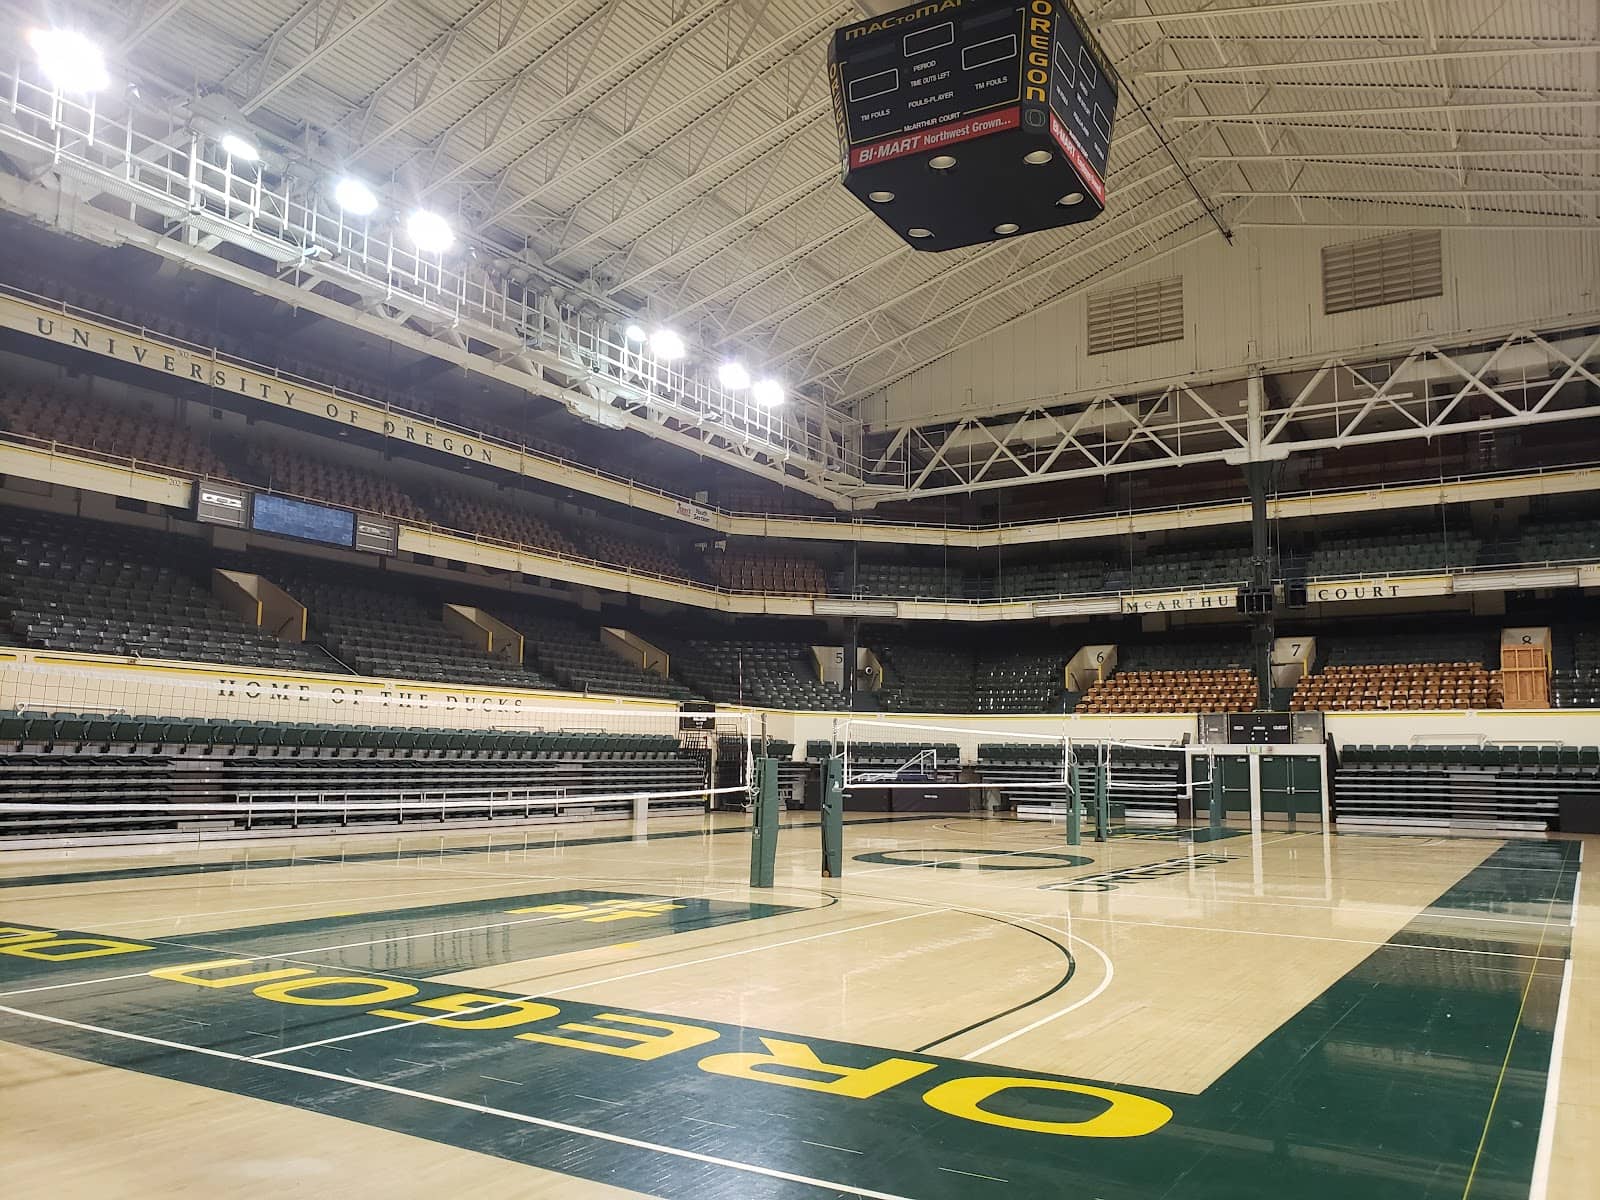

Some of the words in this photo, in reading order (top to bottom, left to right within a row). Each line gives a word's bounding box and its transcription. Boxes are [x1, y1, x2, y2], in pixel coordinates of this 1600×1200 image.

[1026, 0, 1053, 102] OREGON
[913, 60, 937, 72] PERIOD
[910, 79, 922, 87] TIME
[922, 75, 937, 84] OUTS
[937, 70, 951, 80] LEFT
[975, 82, 985, 90] TM
[986, 76, 1008, 87] FOULS
[908, 91, 954, 109] FOULS-PLAYER
[861, 112, 870, 121] TM
[870, 108, 891, 120] FOULS
[904, 118, 938, 132] McARTHUR
[938, 112, 961, 123] COURT
[923, 126, 970, 145] Northwest
[37, 316, 294, 405] UNIVERSITY
[326, 403, 359, 424] OF
[383, 420, 493, 462] OREGON
[1318, 585, 1400, 601] COURT
[835, 652, 843, 664] 5
[1096, 651, 1104, 664] 6
[1291, 643, 1301, 657] 7
[218, 679, 310, 701] HOME
[332, 687, 364, 705] OF
[381, 691, 429, 708] THE
[446, 695, 522, 714] DUCKS
[148, 957, 1174, 1138] OREGON
